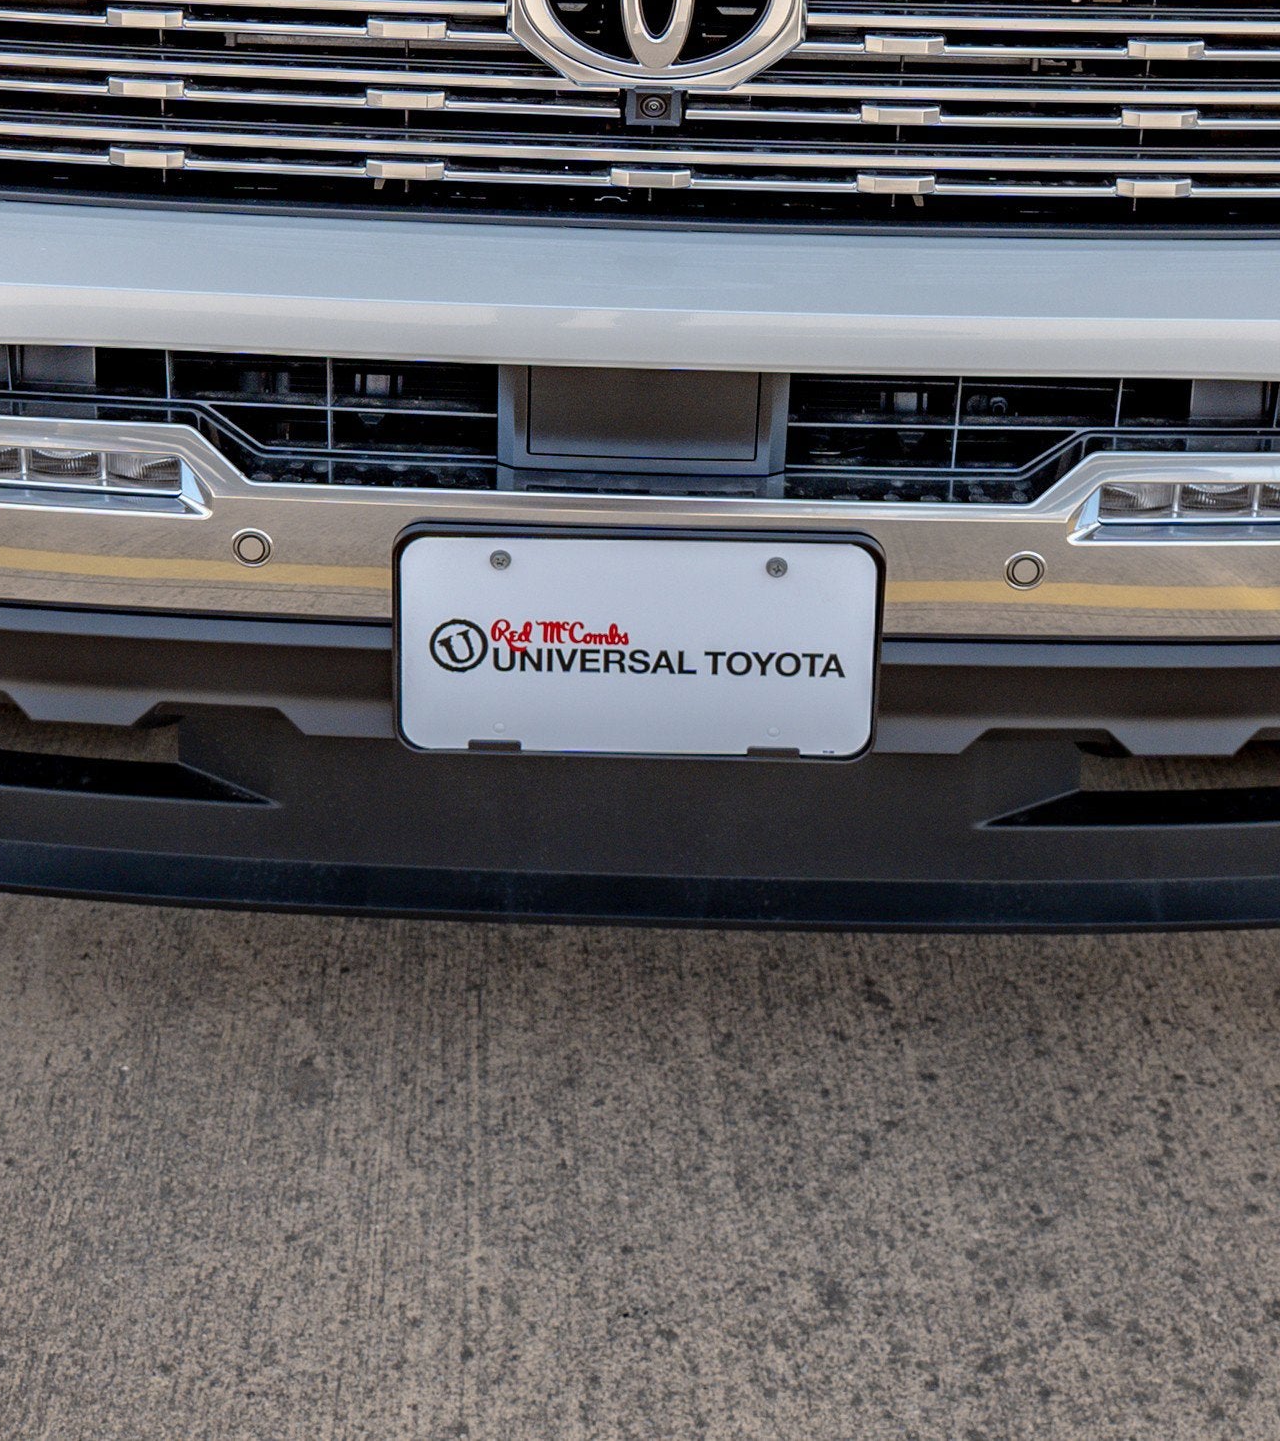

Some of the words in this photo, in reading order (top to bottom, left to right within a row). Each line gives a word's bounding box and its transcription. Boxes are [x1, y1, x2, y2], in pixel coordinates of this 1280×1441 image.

[491, 618, 533, 652] Red
[536, 620, 630, 646] McCombs
[492, 646, 698, 676] UNIVERSAL
[704, 650, 846, 679] TOYOTA
